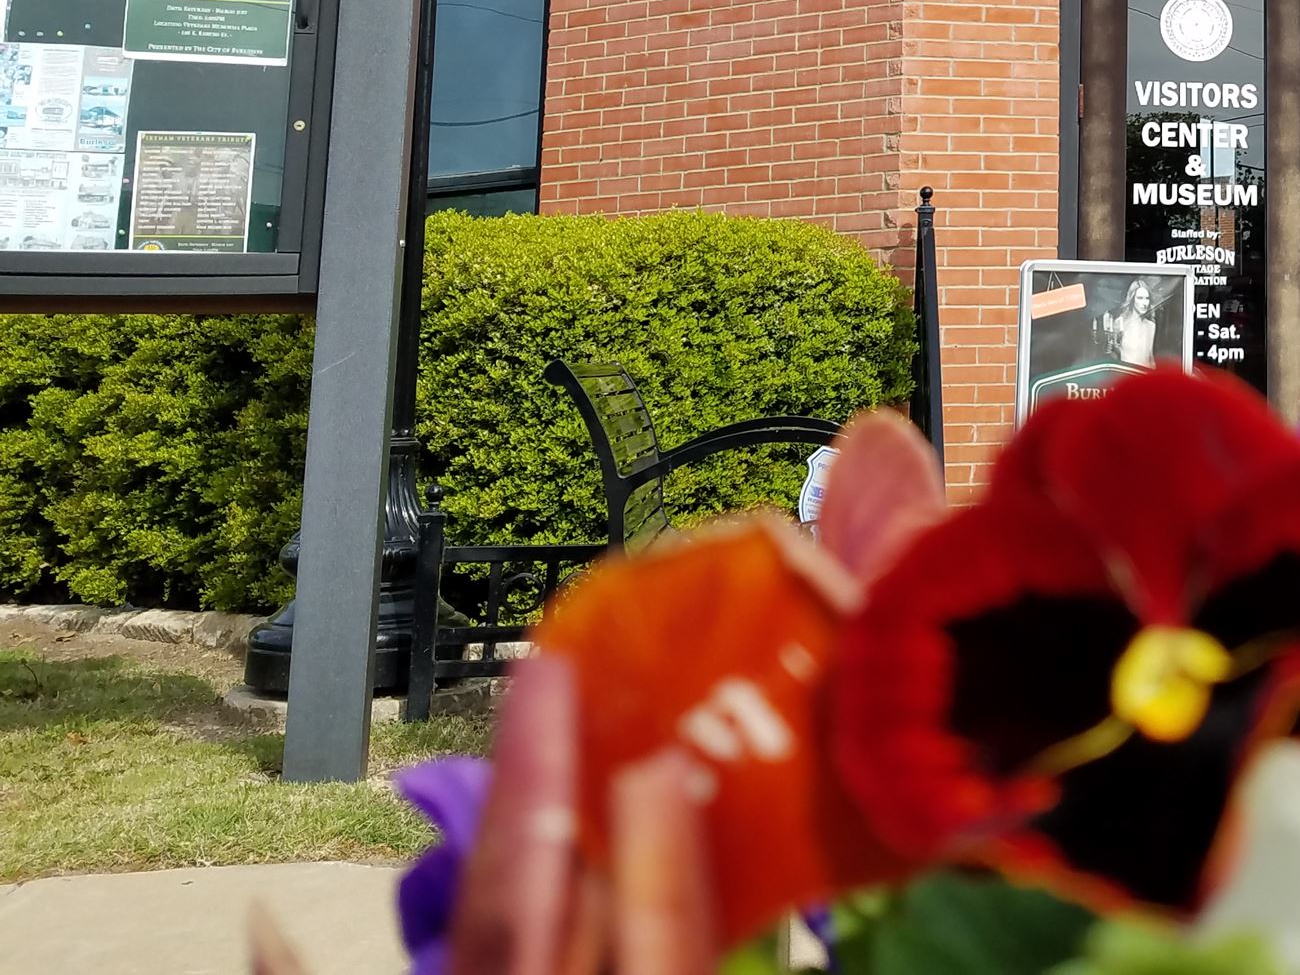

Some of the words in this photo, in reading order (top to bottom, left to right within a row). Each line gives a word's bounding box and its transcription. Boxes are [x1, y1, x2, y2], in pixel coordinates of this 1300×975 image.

[1134, 80, 1258, 109] VISITORS
[1141, 121, 1249, 149] CENTER
[1184, 154, 1208, 177] &
[1132, 183, 1258, 207] MUSEUM
[1171, 228, 1205, 238] Staffed
[1156, 244, 1236, 267] BURLESON
[1192, 303, 1221, 319] EN
[1208, 323, 1241, 339] Sat.
[1206, 344, 1245, 363] 4pm
